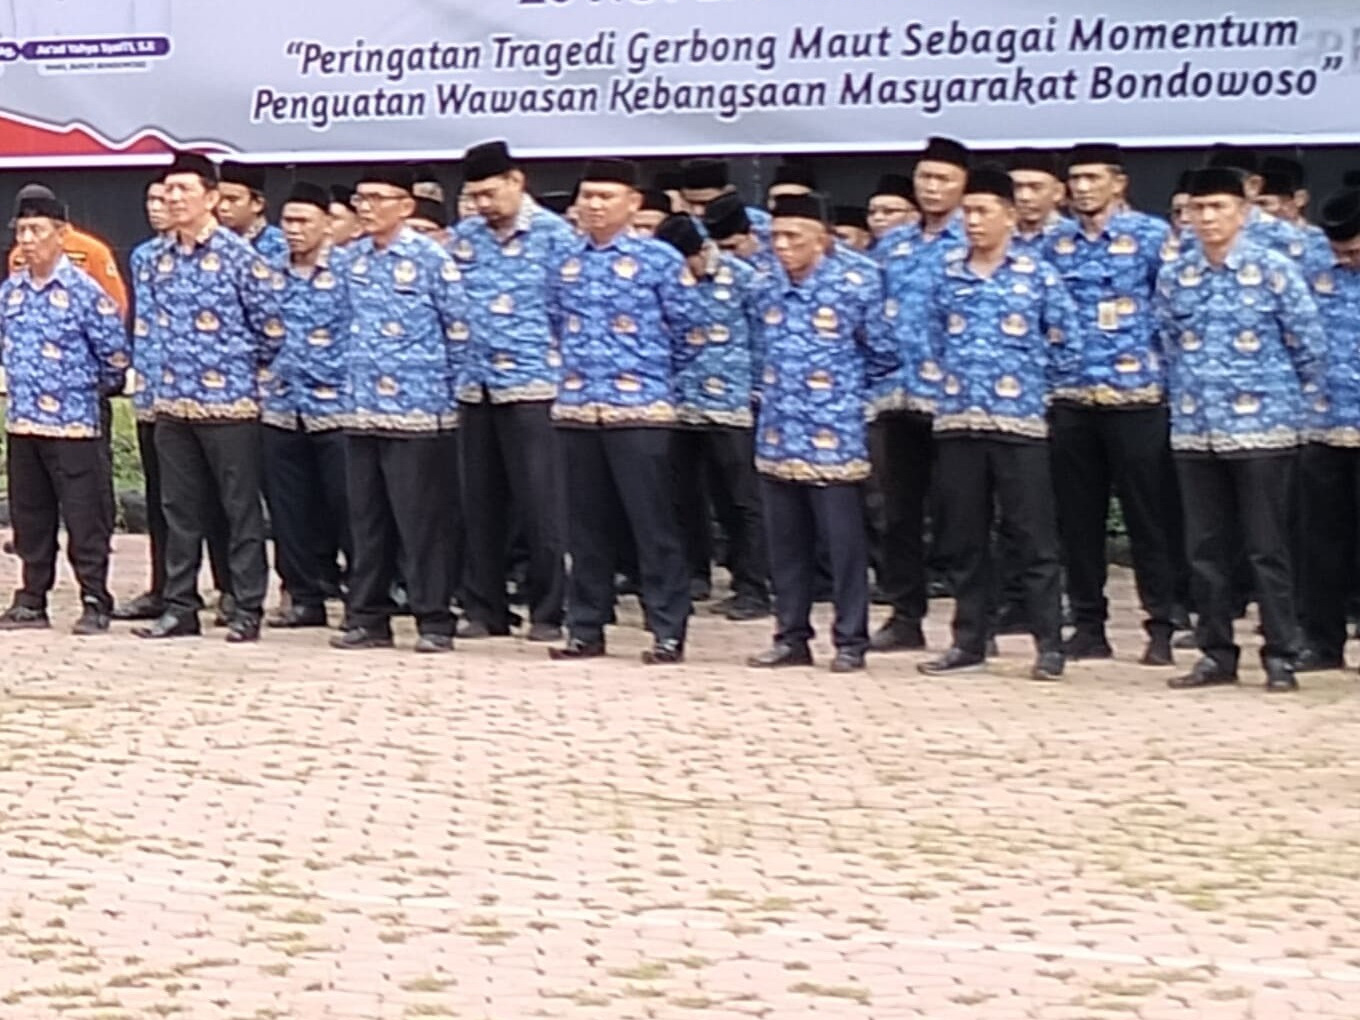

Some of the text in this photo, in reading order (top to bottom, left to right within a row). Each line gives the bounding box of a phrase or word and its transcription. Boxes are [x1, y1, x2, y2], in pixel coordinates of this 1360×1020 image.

[492, 31, 616, 77] Tragedi
[628, 30, 777, 74] Gerbong
[789, 26, 891, 60] Maut
[901, 16, 1057, 63] Sebagai
[1068, 15, 1299, 52] Momentum
[253, 88, 426, 128] Penguatan
[435, 83, 598, 115] Wawasan
[609, 76, 826, 118] Kebangsaan
[839, 67, 1078, 114] Masyarakat
